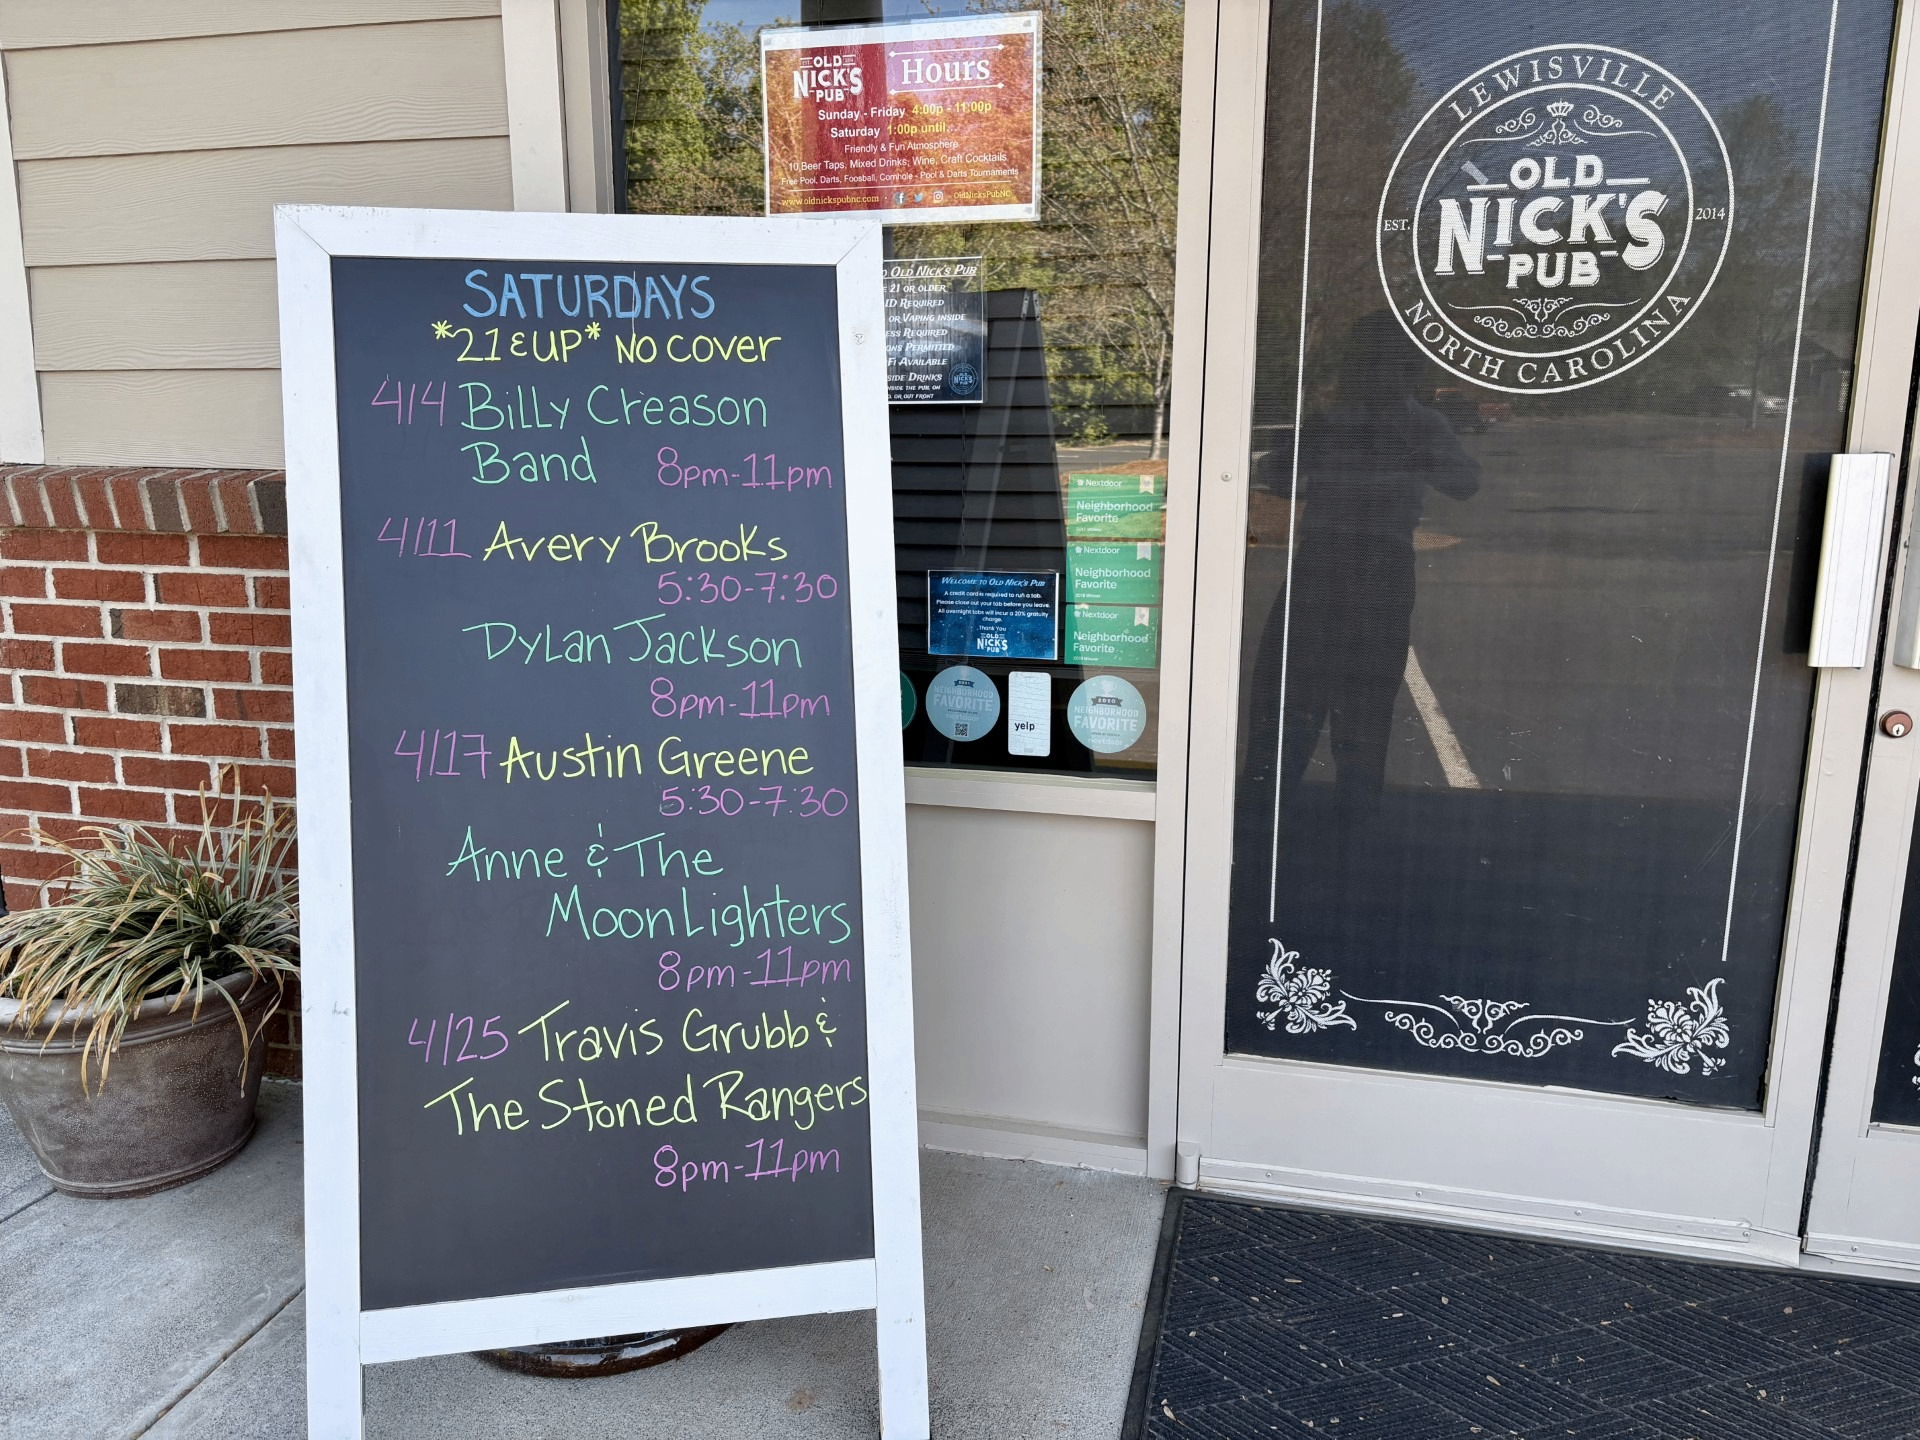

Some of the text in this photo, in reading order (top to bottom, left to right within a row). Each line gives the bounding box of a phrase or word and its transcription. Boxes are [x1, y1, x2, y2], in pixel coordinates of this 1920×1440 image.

[813, 55, 843, 68] OLD
[901, 58, 990, 85] Hours
[793, 67, 863, 99] NICK'S
[1448, 54, 1675, 121] LEWISVILLE
[815, 88, 845, 102] PUB
[818, 101, 992, 121] Sunday Friday 4:00p 11:00p
[830, 126, 880, 139] Saturday
[887, 123, 917, 136] 1:00p
[844, 140, 958, 154] Friendly & Fun Atmosphere
[789, 162, 799, 171] 10
[801, 161, 821, 171] Beer
[849, 159, 876, 169] Mixed
[940, 153, 962, 164] Craft
[965, 152, 1007, 163] Cocktails
[781, 177, 798, 186] Free
[920, 171, 937, 179] Pool
[939, 170, 945, 178] &
[947, 170, 967, 178] Darts
[1509, 154, 1605, 190] OLD
[782, 194, 879, 206] www.oldnickspubnc.com
[1695, 206, 1725, 220] 2014
[1383, 219, 1411, 231] EST.
[1434, 190, 1669, 276] NICK'S
[890, 266, 914, 277] OLD
[916, 265, 951, 277] NICK'S
[954, 264, 978, 275] PUB
[1505, 251, 1602, 289] PUB
[463, 268, 715, 319] SATURDAYS
[889, 283, 900, 293] 21
[884, 298, 945, 309] ID REQUIRED
[902, 313, 935, 322] VAPING
[903, 327, 948, 338] REQUIRED
[1404, 293, 1692, 384] NORTH CAROLINA
[898, 357, 949, 366] AVAILABLE
[908, 372, 943, 382] DRINKS
[460, 435, 832, 491] Band 8pm-11pm
[1085, 479, 1122, 487] Nextdoor
[1076, 500, 1153, 512] Neighborhood
[1076, 512, 1119, 523] Favorite
[377, 516, 788, 564] 4/11 Avery Brooks
[1083, 546, 1120, 554] Nextdoor
[1075, 567, 1151, 579] Neighborhood
[658, 571, 838, 605] 5:30-7:30
[941, 576, 977, 585] WELCOME
[988, 578, 1004, 586] OLD
[1075, 579, 1117, 589] Favorite
[1082, 610, 1118, 619] Nextdoor
[613, 613, 802, 668] Jackson
[1073, 631, 1149, 643] Neighborhood
[1073, 642, 1115, 653] Favorite
[649, 676, 831, 719] 8pm-11pm
[934, 685, 994, 699] NEIGHBORHOOD
[933, 693, 993, 712] FAVORITE
[1074, 705, 1139, 718] NEIGHBORHOOD
[1014, 721, 1035, 732] yelp
[1073, 715, 1138, 732] FAVORITE
[394, 729, 814, 783] 4/17 Austin Greene
[660, 784, 849, 817] 5:30-7:30
[446, 825, 568, 882] Anne
[613, 832, 724, 878] The
[657, 945, 852, 993] 8pm-11pm
[407, 1012, 509, 1066] 4/25
[518, 1000, 664, 1061] Travis
[682, 1008, 809, 1053] Grubb
[424, 1070, 868, 1136] The Stoned Rangers
[653, 1137, 841, 1192] 8pm-11pm
